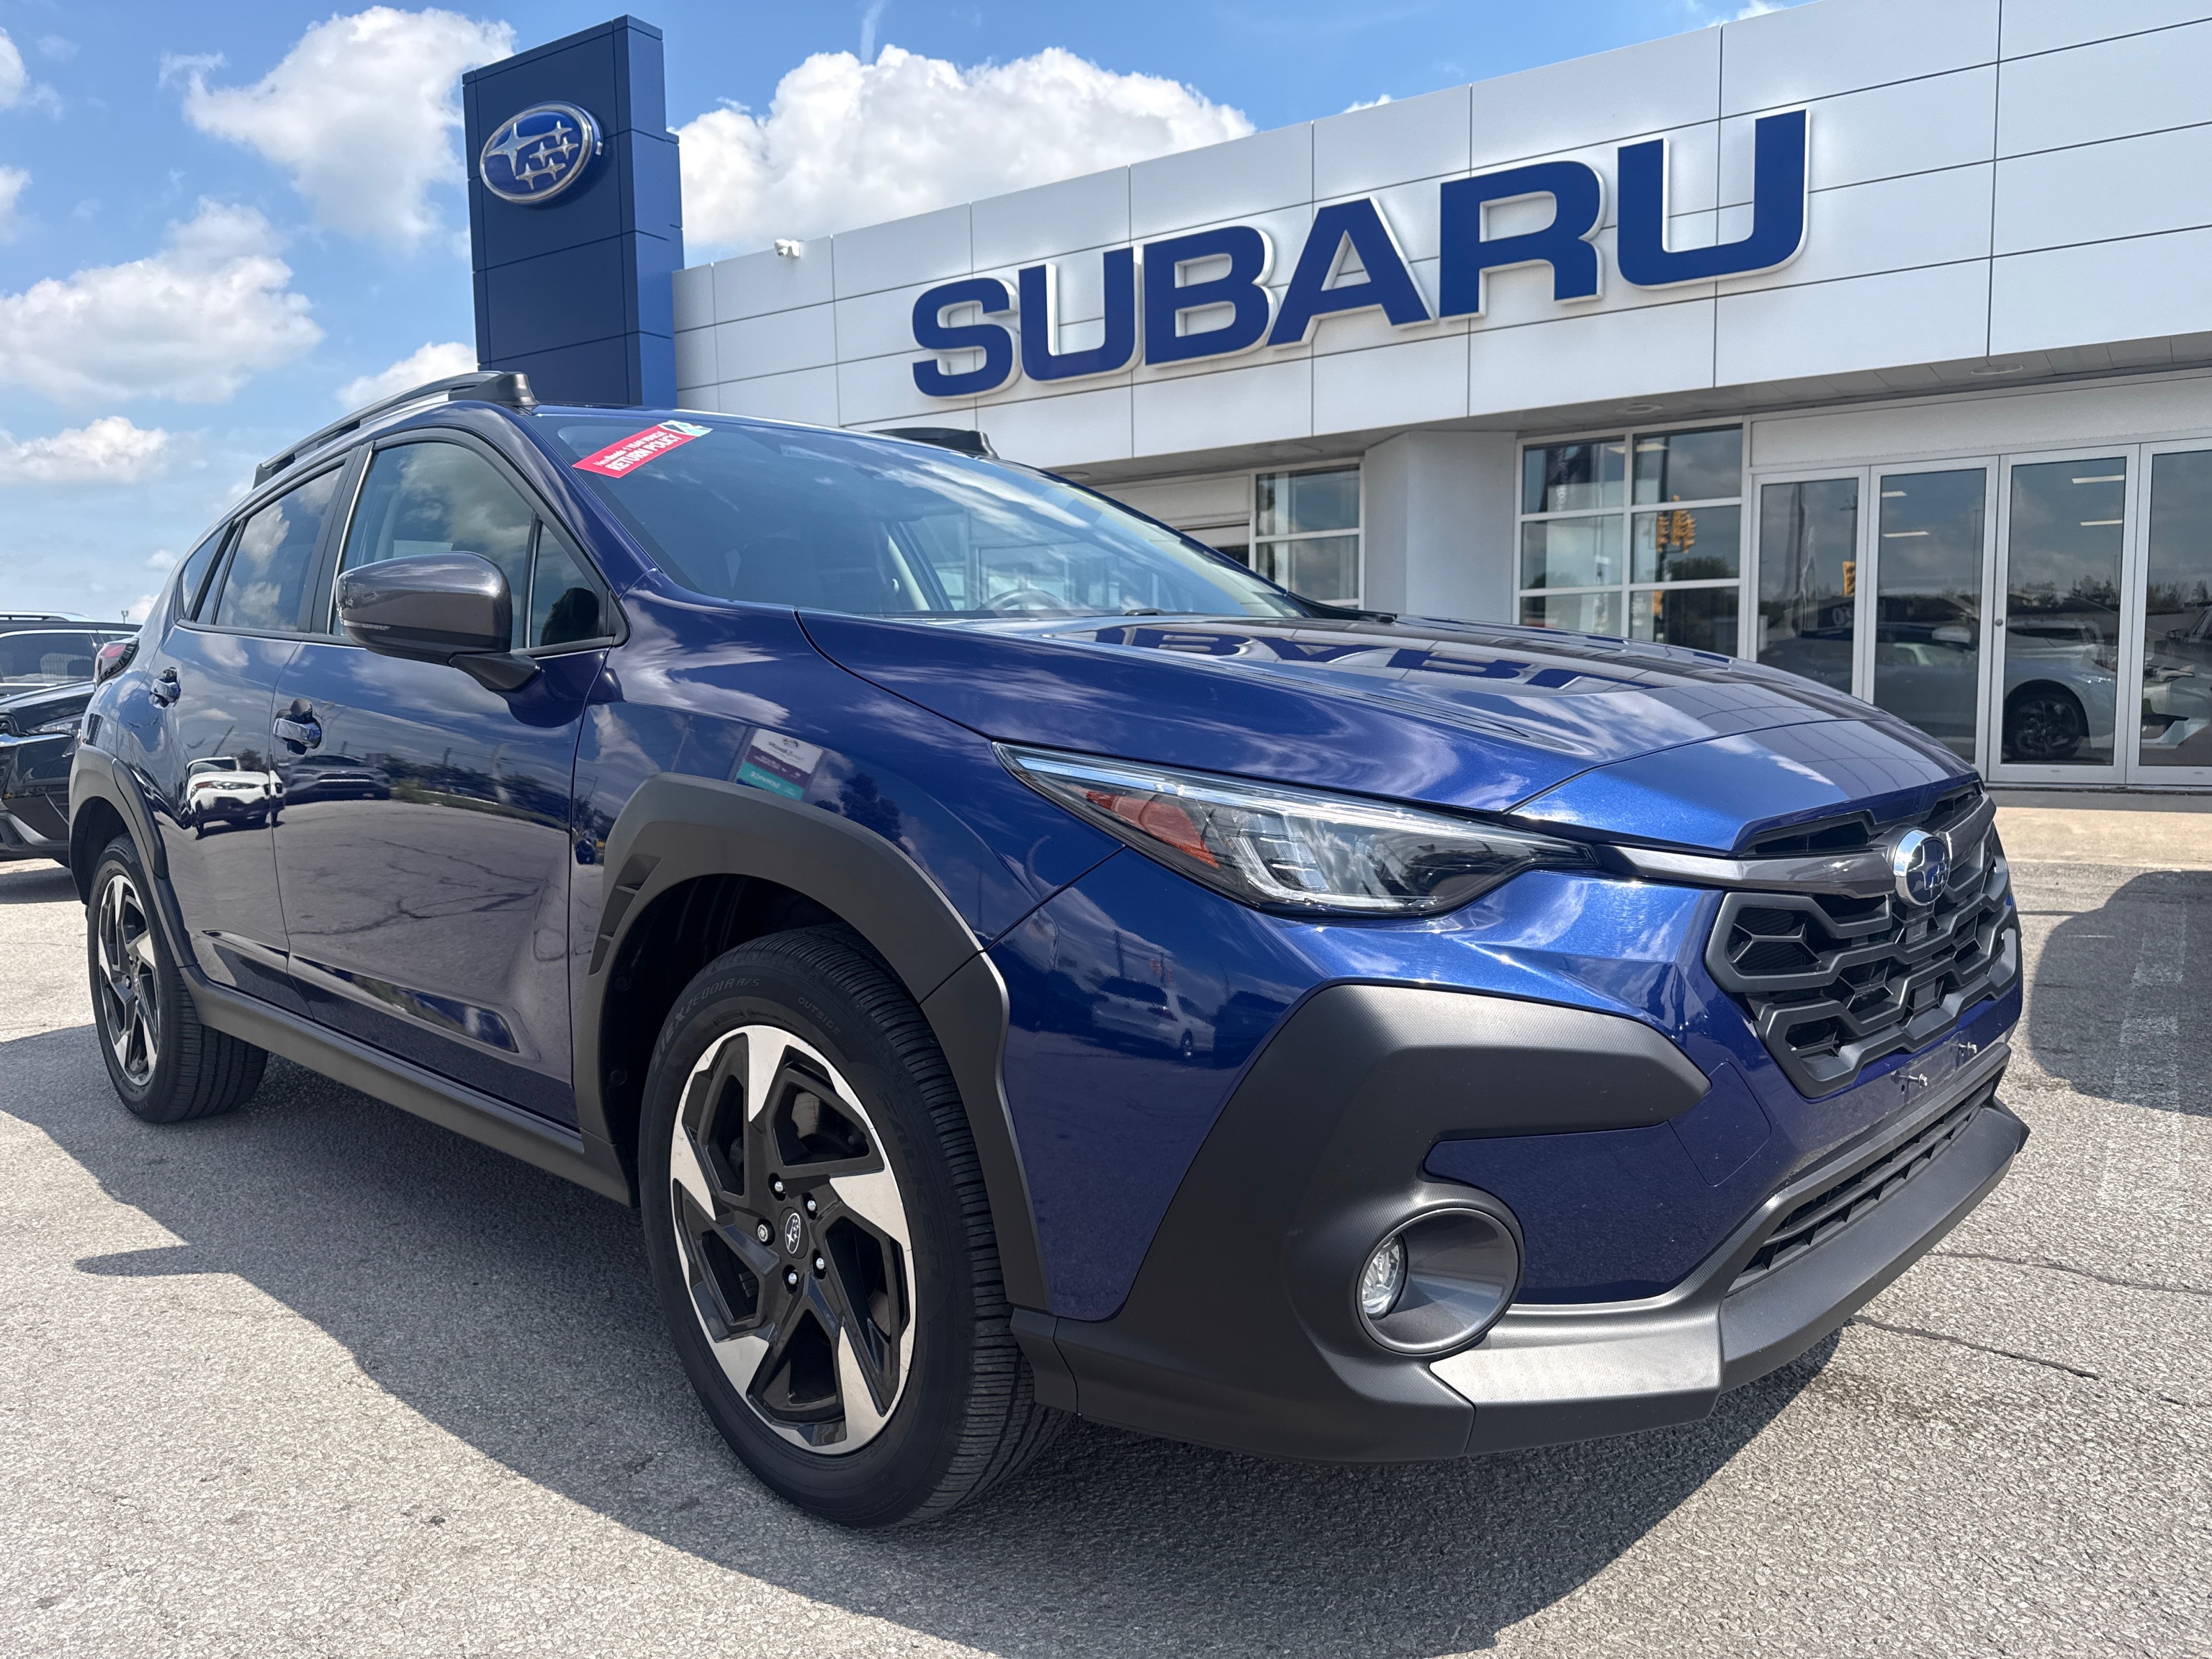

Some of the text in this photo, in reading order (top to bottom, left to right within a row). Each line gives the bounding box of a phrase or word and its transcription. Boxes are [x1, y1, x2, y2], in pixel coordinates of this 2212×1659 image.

[912, 109, 1809, 397] SUBARU
[605, 433, 683, 471] RETURN POLICY
[652, 1007, 685, 1073] ZIEX
[736, 976, 761, 988] A/S
[797, 996, 842, 1036] OUTSIDE
